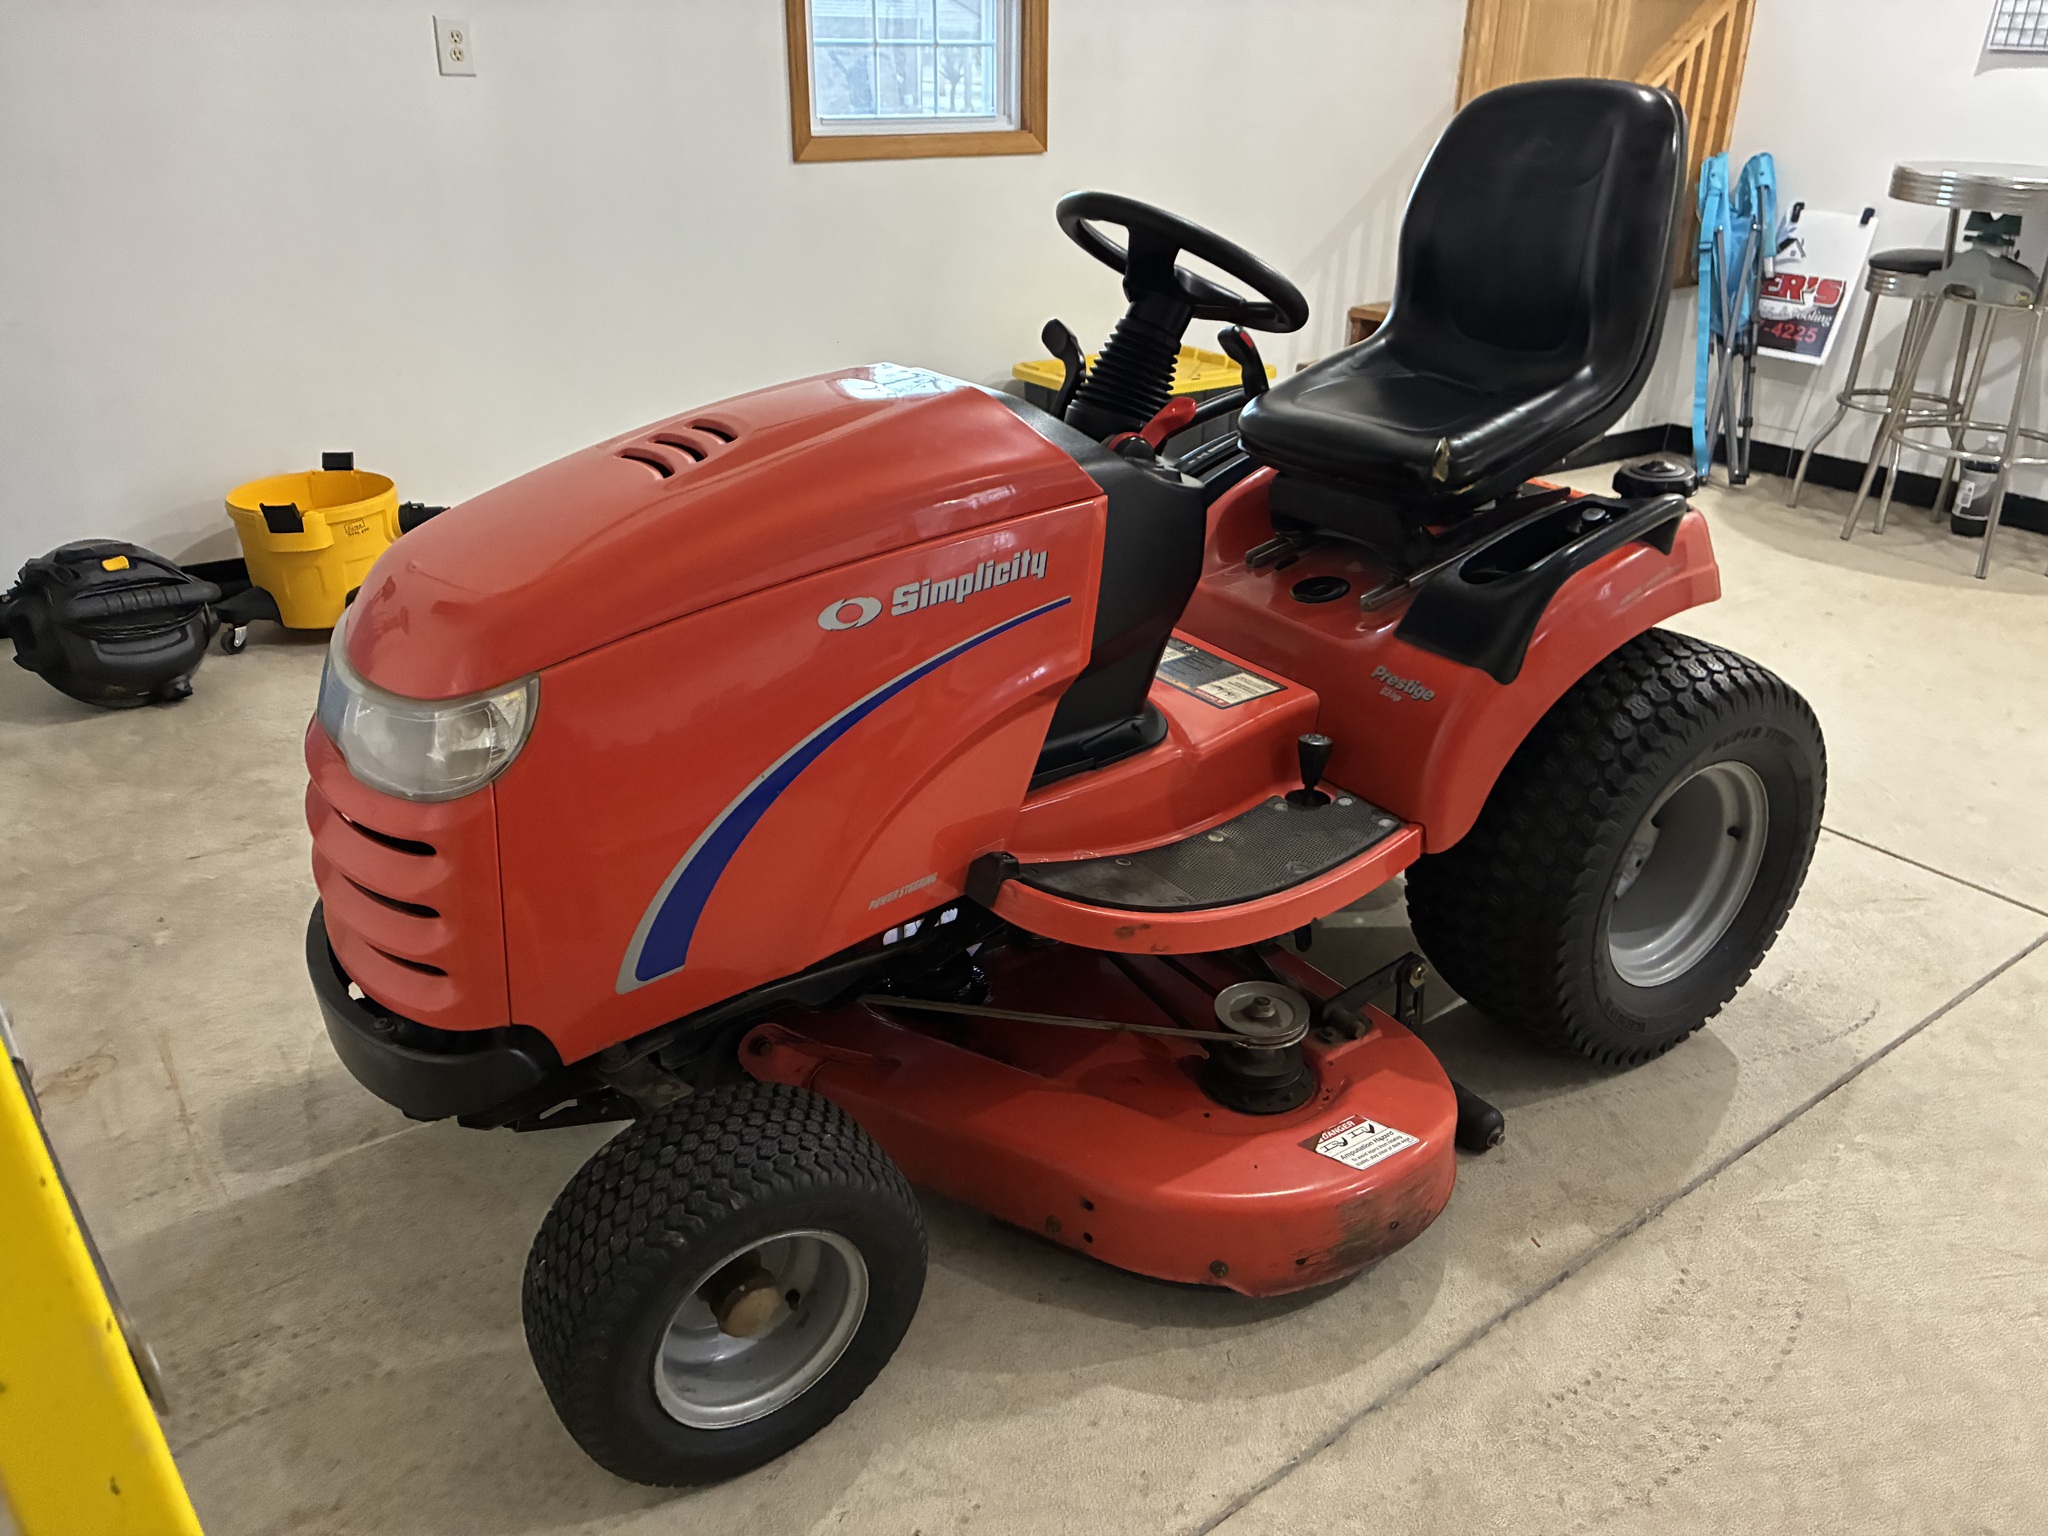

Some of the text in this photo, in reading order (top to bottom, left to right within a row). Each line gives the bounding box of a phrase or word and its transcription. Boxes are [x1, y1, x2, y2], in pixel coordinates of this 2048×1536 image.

[891, 549, 1048, 616] Simplicity
[1370, 664, 1435, 702] Prestige
[1321, 1120, 1356, 1140] DANGER
[1340, 1131, 1395, 1160] Amputation Hazard
